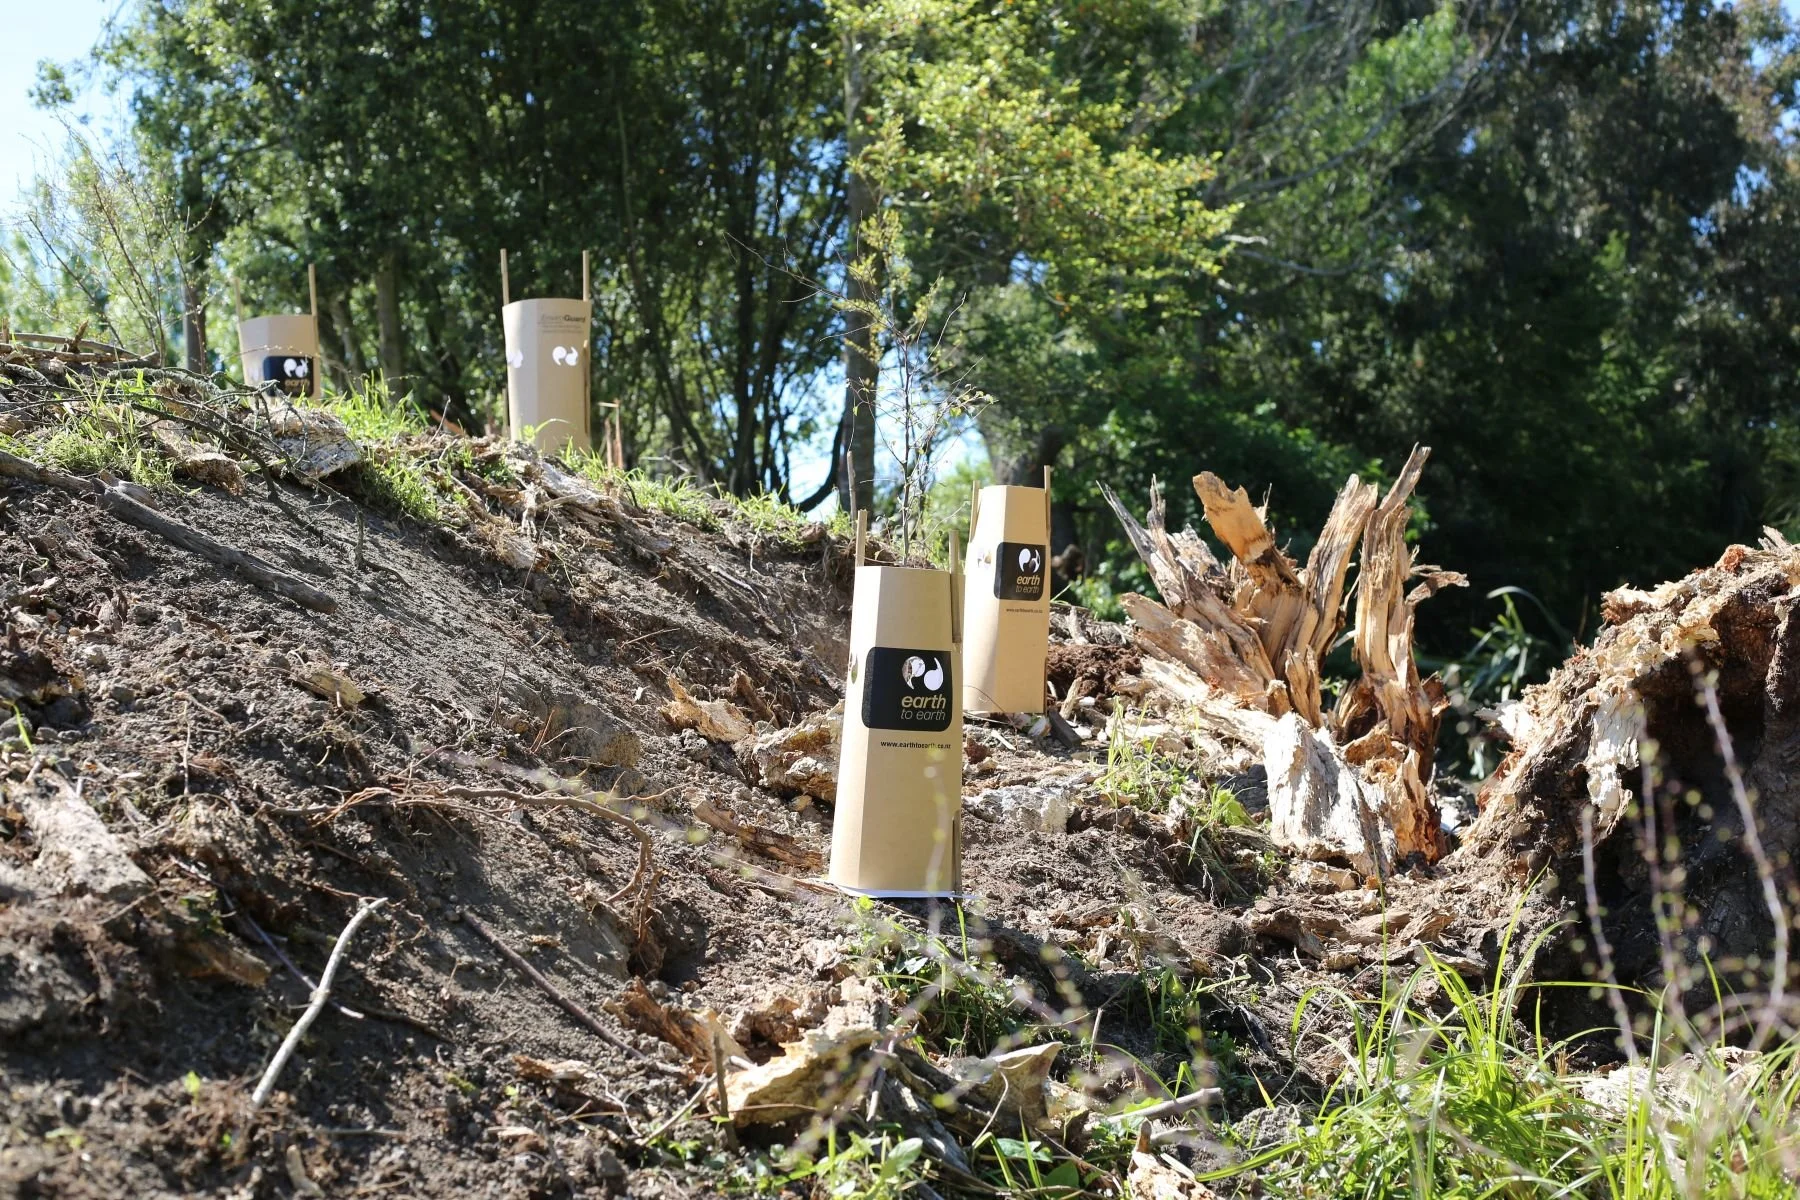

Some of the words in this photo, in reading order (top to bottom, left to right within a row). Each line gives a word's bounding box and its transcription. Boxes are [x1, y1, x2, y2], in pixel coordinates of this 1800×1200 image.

[1016, 574, 1041, 586] earth
[1015, 585, 1023, 593] to
[1023, 586, 1040, 594] earth
[901, 693, 947, 709] earth
[900, 709, 913, 720] to
[916, 709, 946, 721] earth
